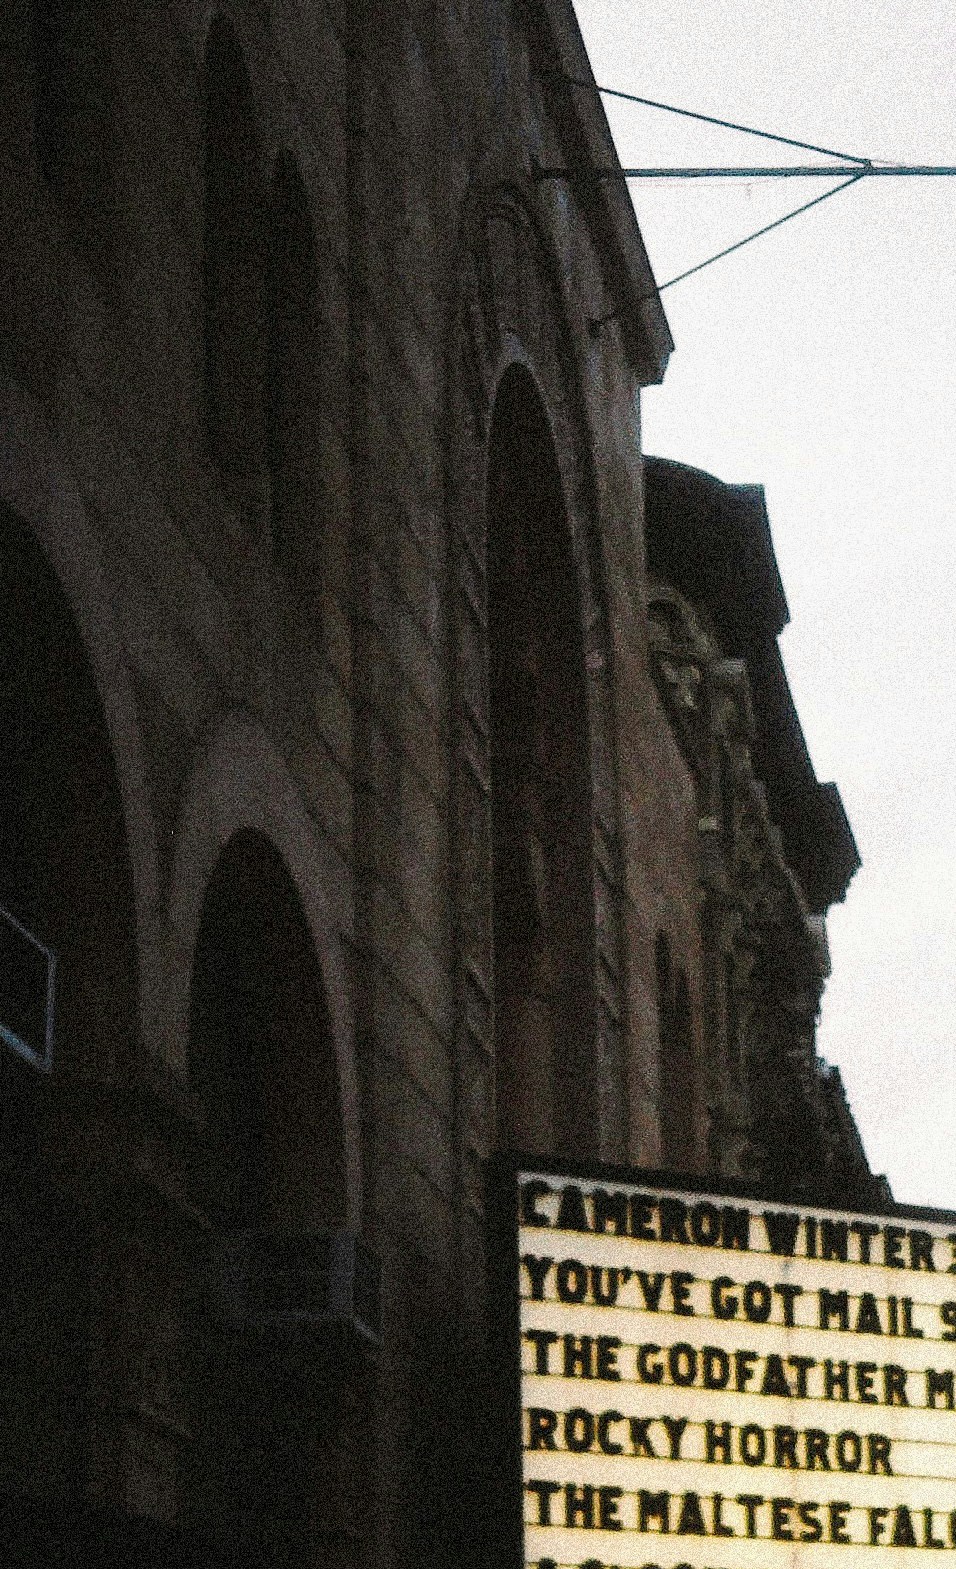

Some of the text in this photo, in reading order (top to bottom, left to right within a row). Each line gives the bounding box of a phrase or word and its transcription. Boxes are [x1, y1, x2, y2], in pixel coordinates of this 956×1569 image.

[520, 1180, 750, 1251] CAMERON
[522, 1254, 695, 1316] YOU'VE
[711, 1276, 801, 1326] GOT
[819, 1288, 923, 1338] MAIL
[525, 1329, 621, 1381] THE
[637, 1342, 908, 1406] GODFATHER
[526, 1407, 892, 1475] ROCKY HORROR
[526, 1480, 623, 1530] THE
[640, 1490, 852, 1543] MALTESE
